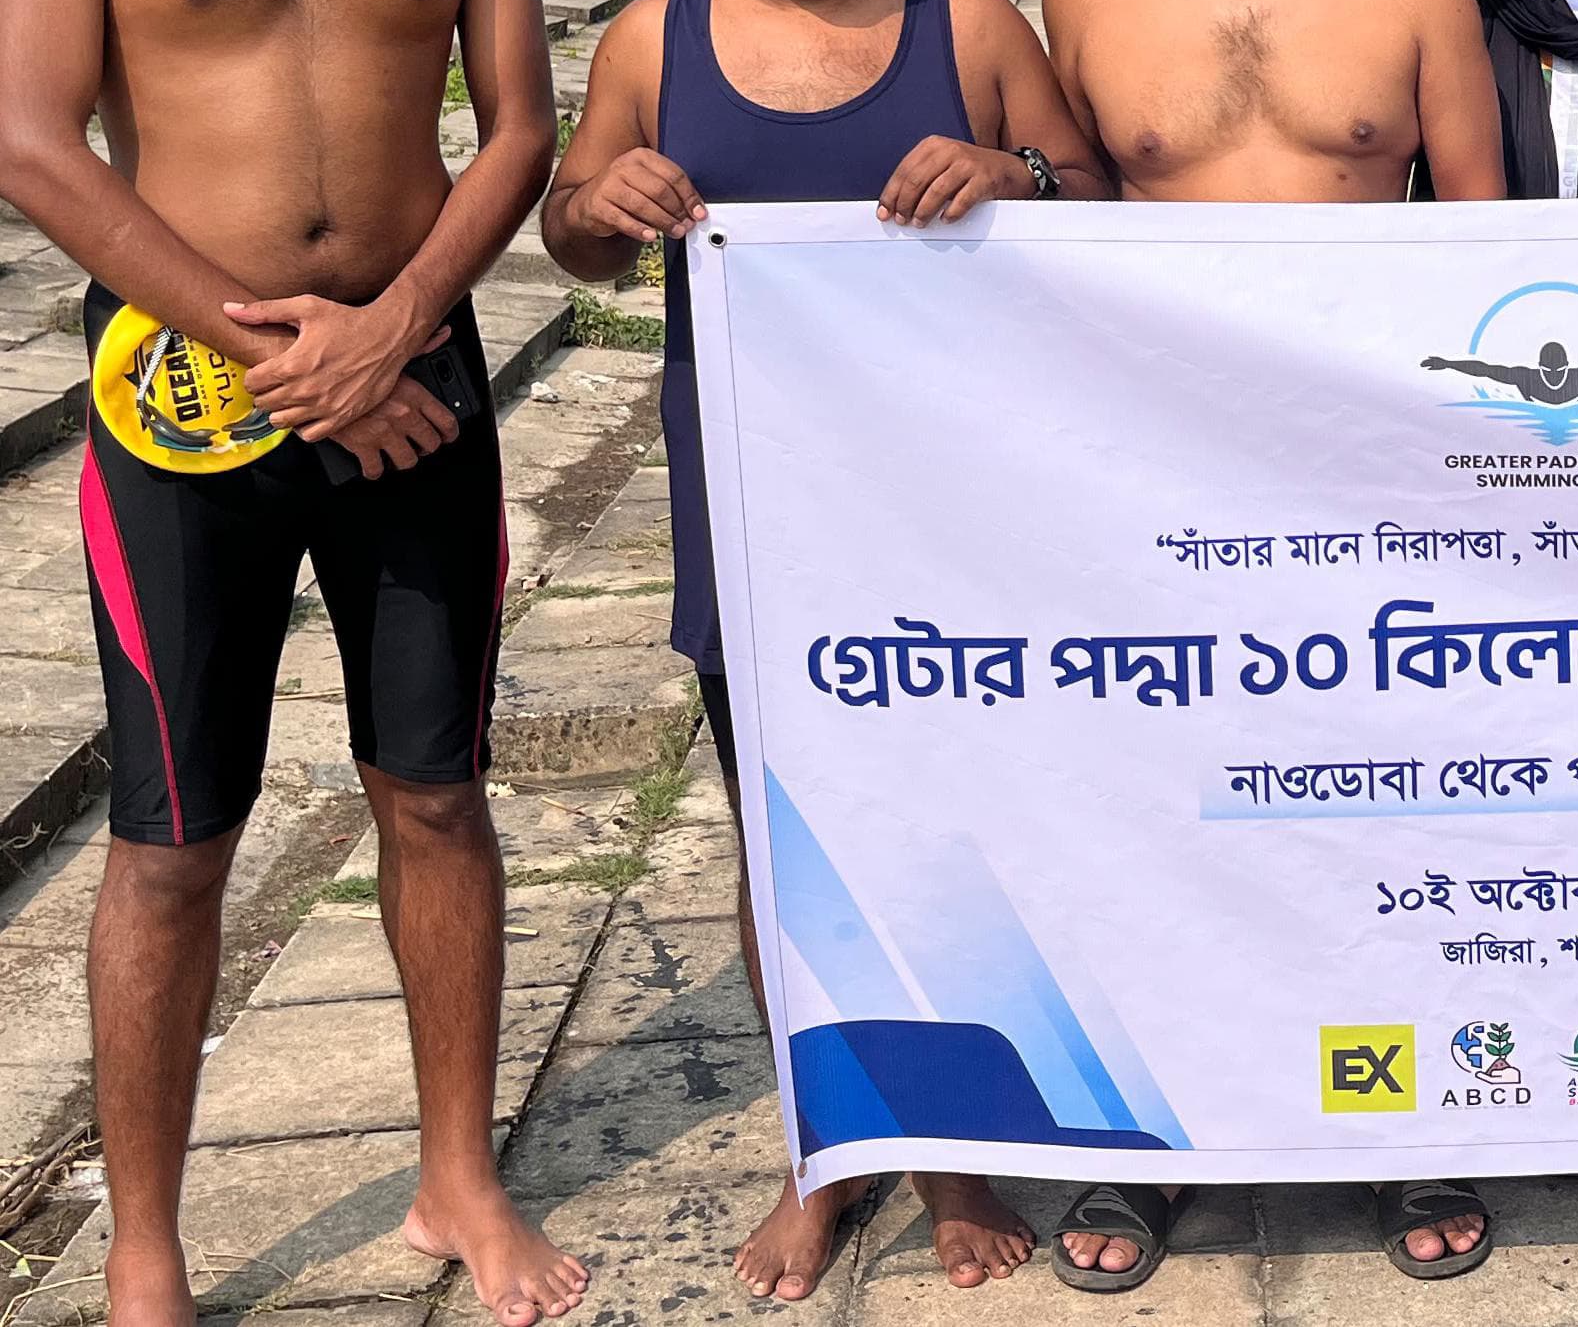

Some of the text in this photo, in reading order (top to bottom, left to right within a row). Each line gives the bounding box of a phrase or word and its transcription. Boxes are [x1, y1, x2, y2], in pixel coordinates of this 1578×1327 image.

[1445, 455, 1531, 468] GREATER
[1285, 532, 1364, 565] মানে
[808, 617, 1028, 707] গ্রেটার
[1051, 635, 1217, 706] পদ্মা
[1240, 634, 1348, 695] ১০
[1224, 758, 1425, 805] নাওডোবা
[1440, 754, 1552, 798] থেকে
[1377, 870, 1457, 915] ১০ই
[1440, 933, 1547, 968] জাজিরা,
[1332, 1044, 1404, 1094] EX
